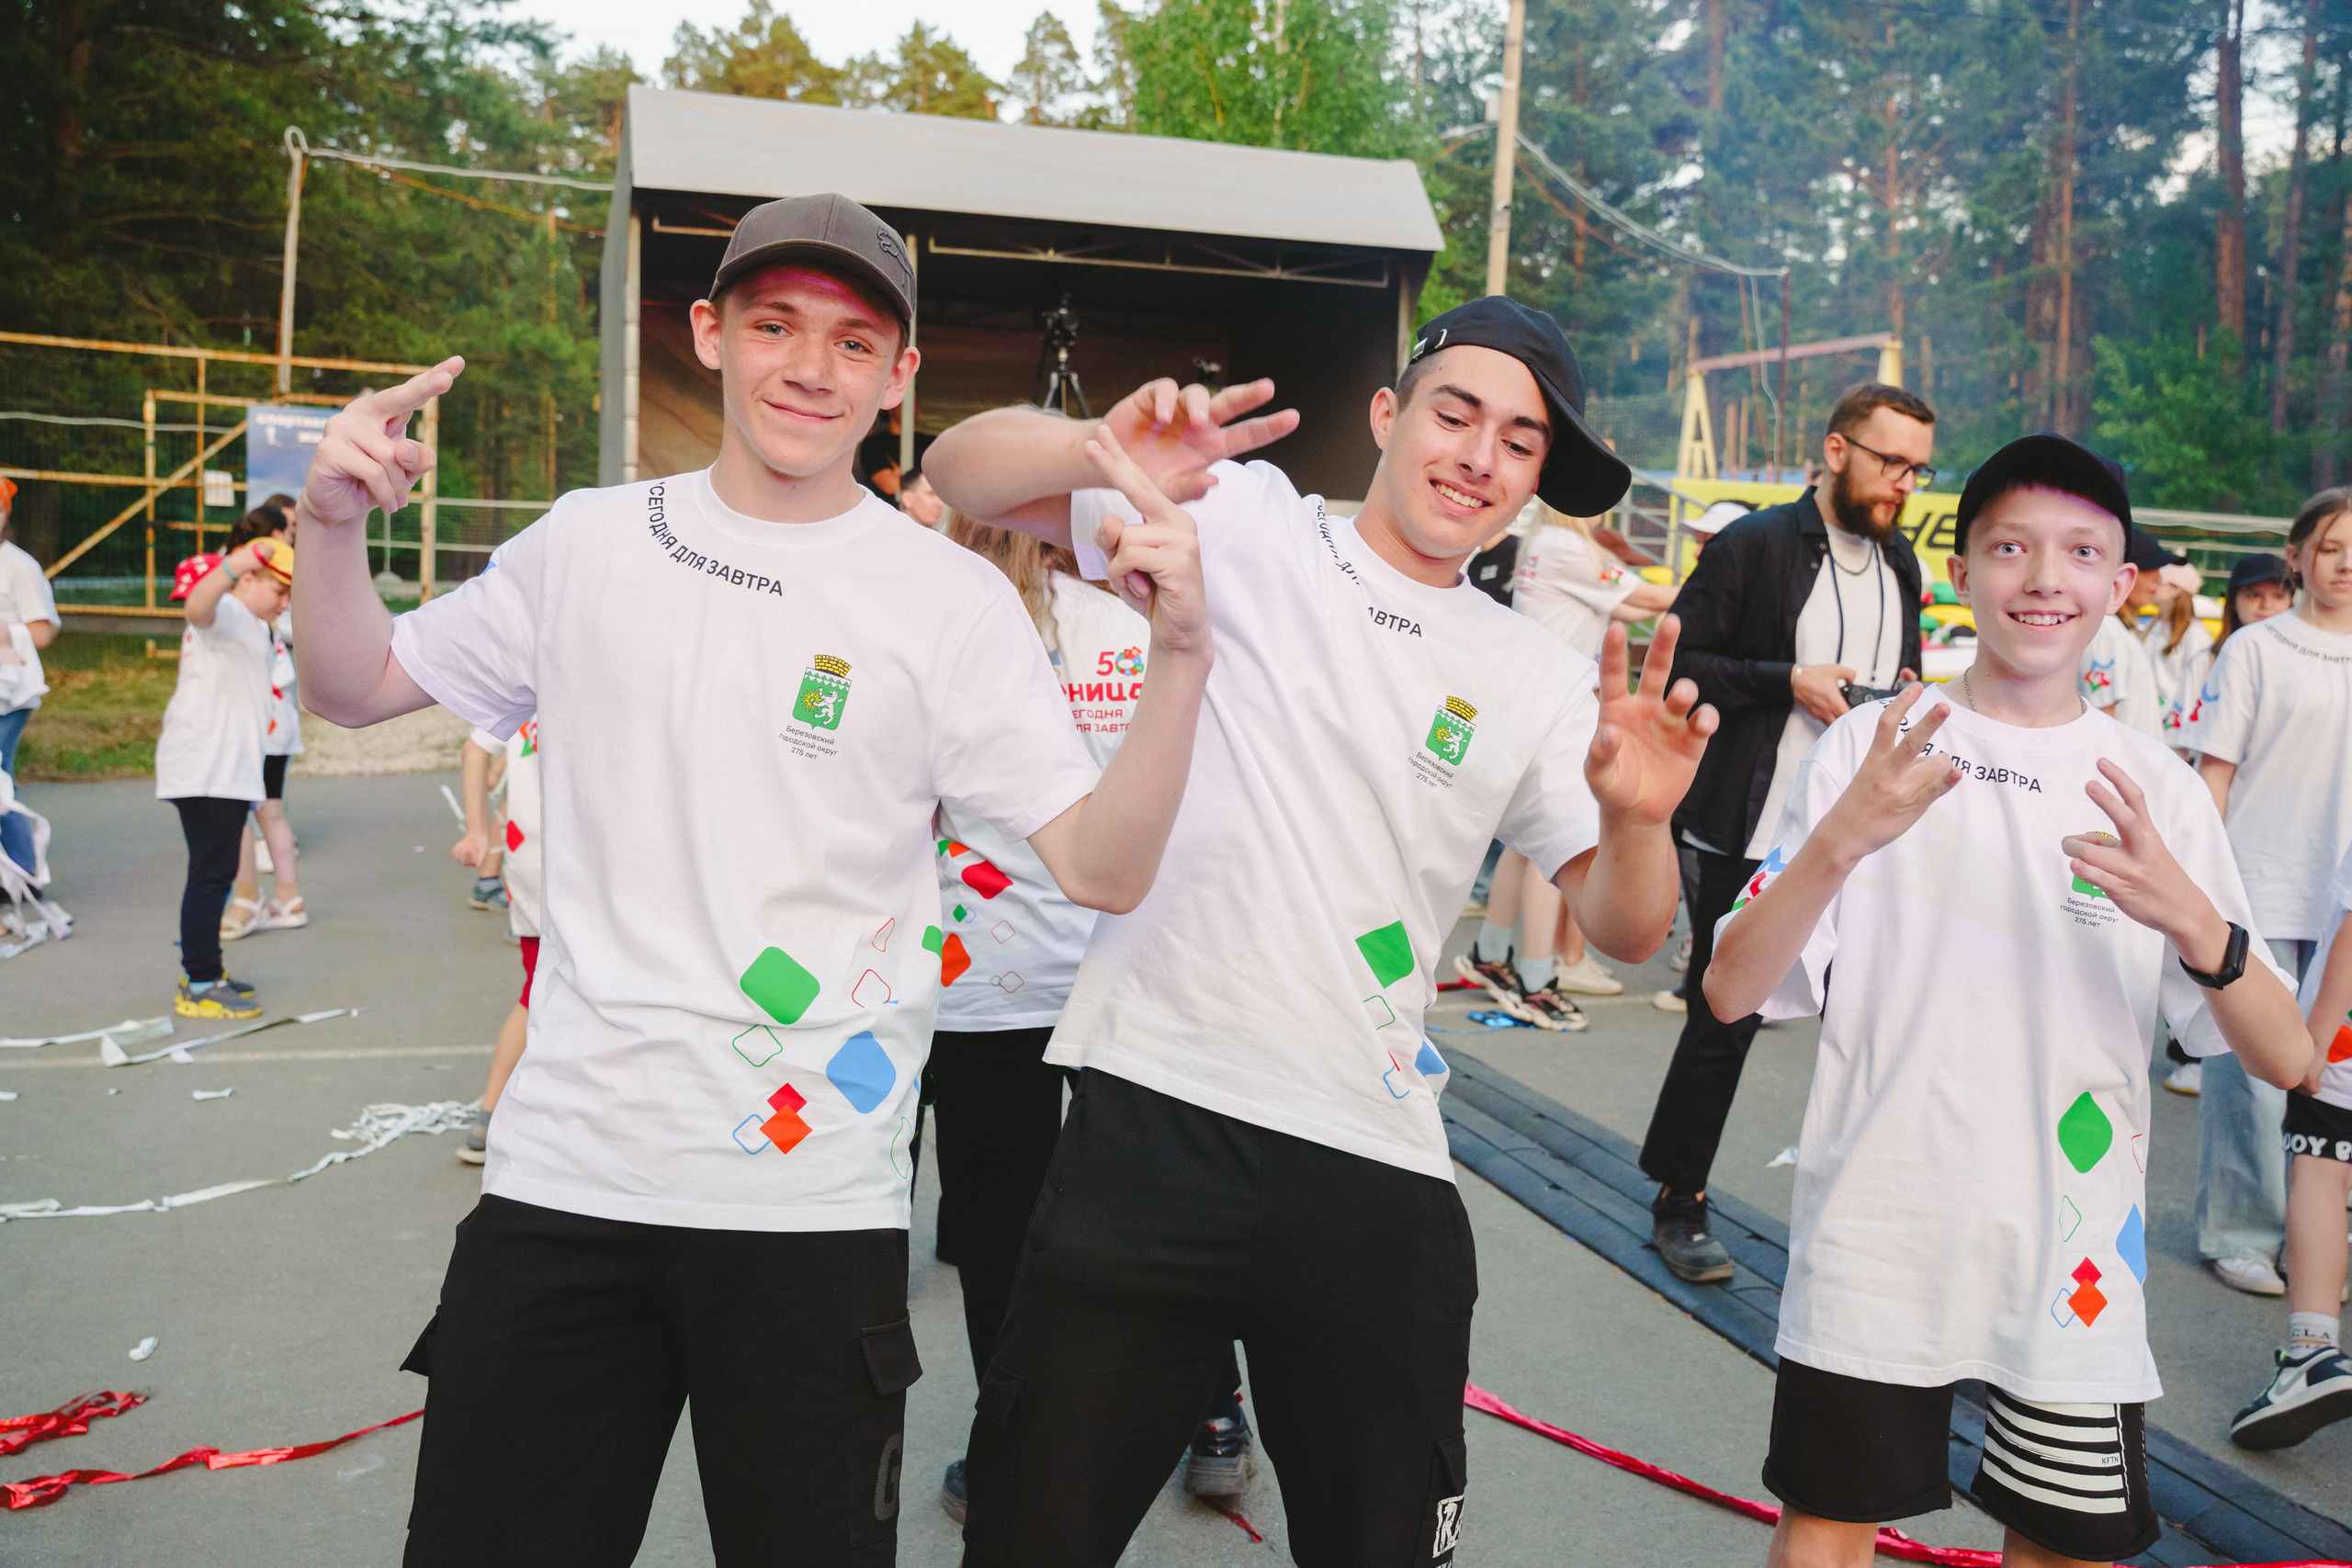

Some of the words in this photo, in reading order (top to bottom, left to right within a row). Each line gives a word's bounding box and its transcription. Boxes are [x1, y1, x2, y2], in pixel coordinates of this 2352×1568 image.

[669, 545, 707, 571] ДЛЯ
[707, 559, 783, 597] ЗАВТРА
[1071, 709, 1123, 720] ЕГОДНЯ
[779, 733, 816, 750] городской
[817, 746, 838, 756] округ
[786, 725, 834, 745] Березовский
[791, 747, 804, 756] 275
[1408, 757, 1437, 778] городской
[1437, 776, 1453, 788] округ
[1416, 751, 1453, 778] Березовский
[1416, 773, 1428, 783] 275
[1974, 766, 2041, 793] ЗАВТРА
[2060, 905, 2098, 918] городской
[2098, 914, 2119, 923] округ
[2066, 897, 2115, 913] Березовский
[2075, 917, 2086, 925] 275
